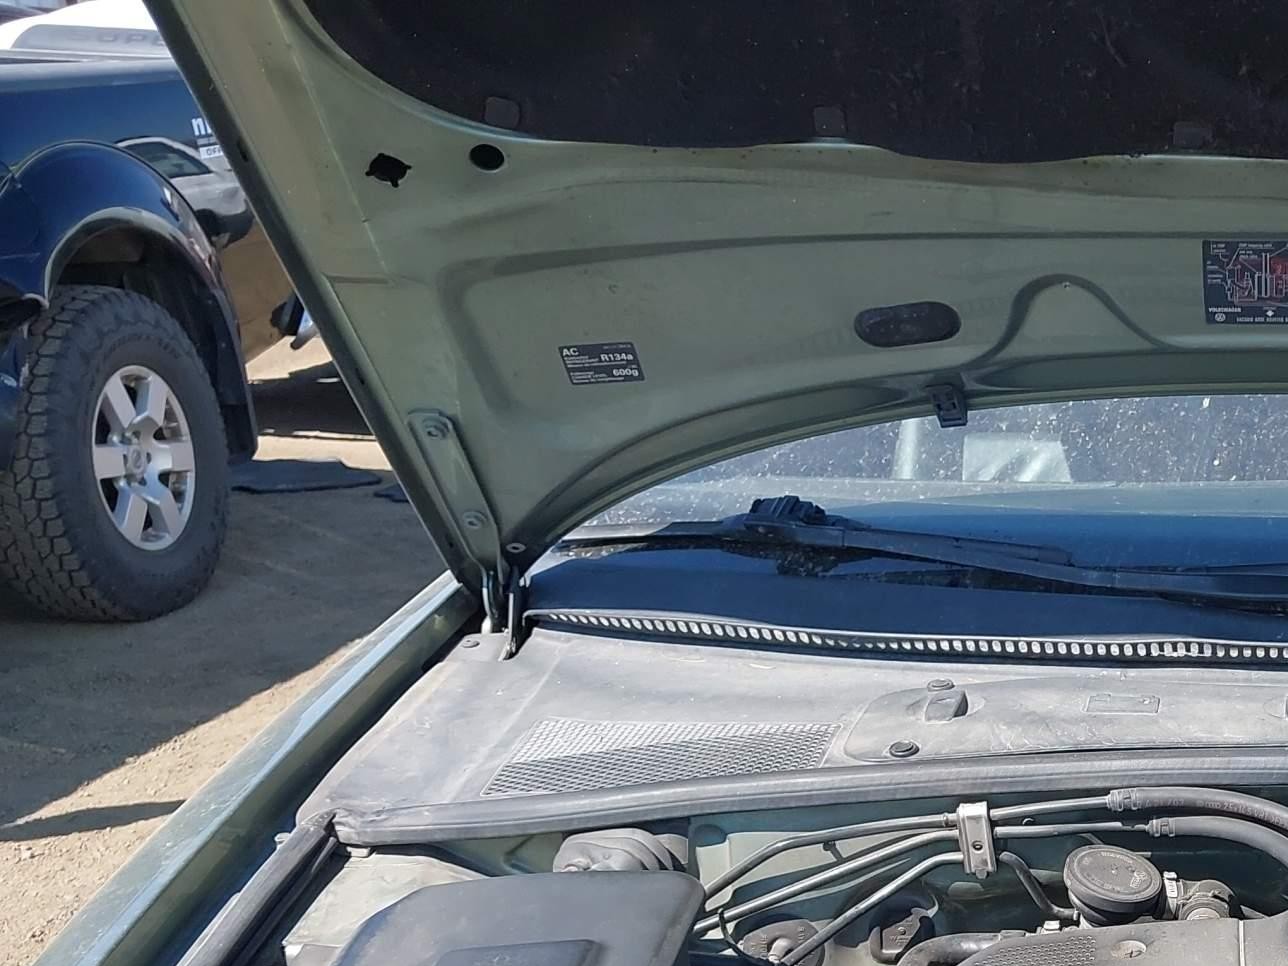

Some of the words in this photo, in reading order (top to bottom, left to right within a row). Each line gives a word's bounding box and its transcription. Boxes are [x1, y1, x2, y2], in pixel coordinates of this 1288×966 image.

[562, 347, 579, 356] AC
[599, 353, 634, 362] R134a
[612, 368, 639, 377] 600g
